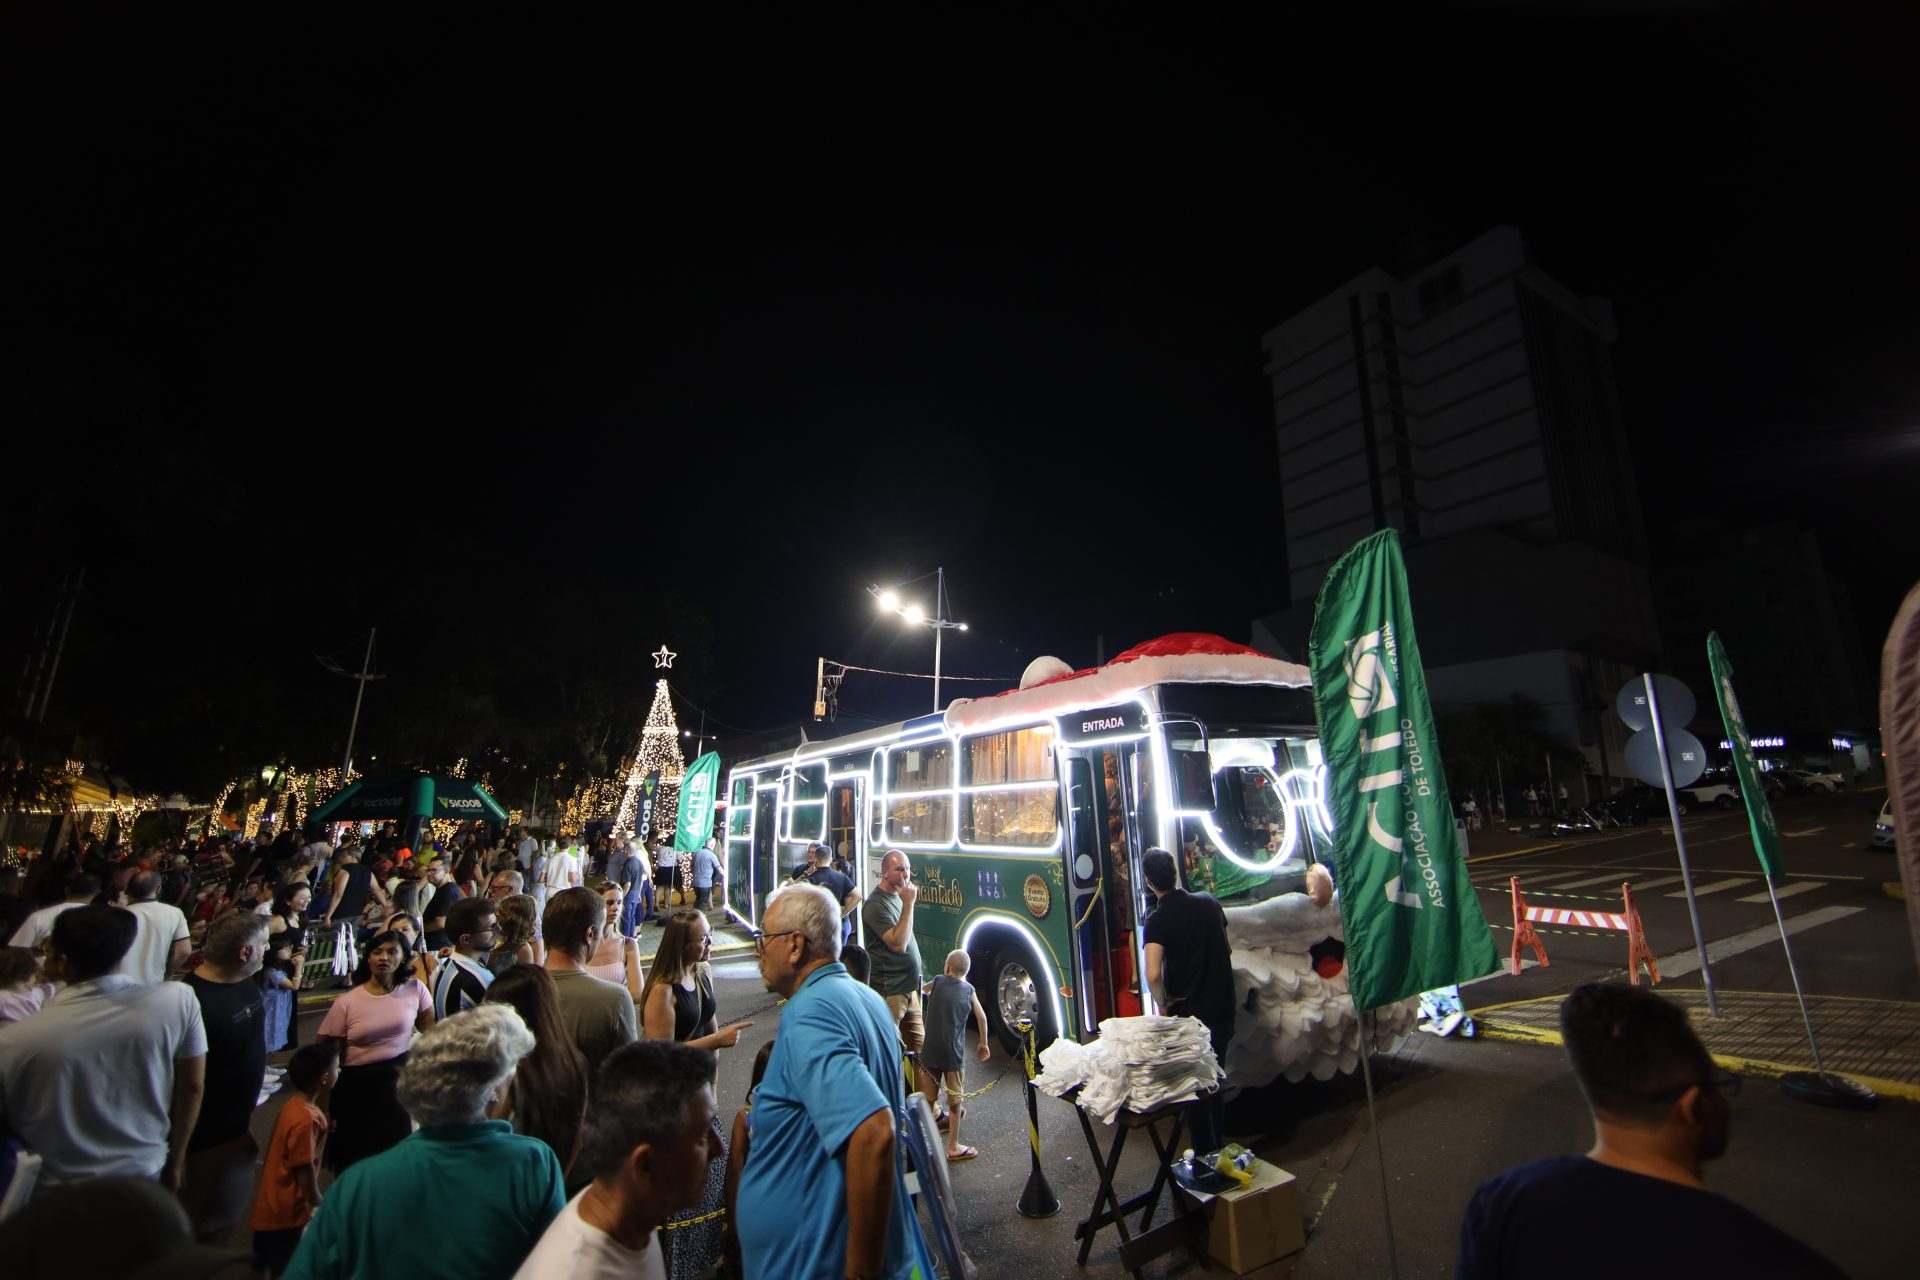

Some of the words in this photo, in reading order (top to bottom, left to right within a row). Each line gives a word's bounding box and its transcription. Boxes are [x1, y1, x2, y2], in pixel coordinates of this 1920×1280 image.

[1082, 716, 1125, 733] ENTRADA
[1400, 718, 1425, 775] TOLEDO
[1750, 737, 1785, 748] MODAS
[1416, 777, 1431, 797] DE
[449, 799, 482, 808] SICOOB
[685, 792, 705, 837] ACIT
[640, 800, 652, 843] COOB
[1403, 810, 1445, 908] ASSOCIAÇÃO
[916, 878, 963, 907] ncantado
